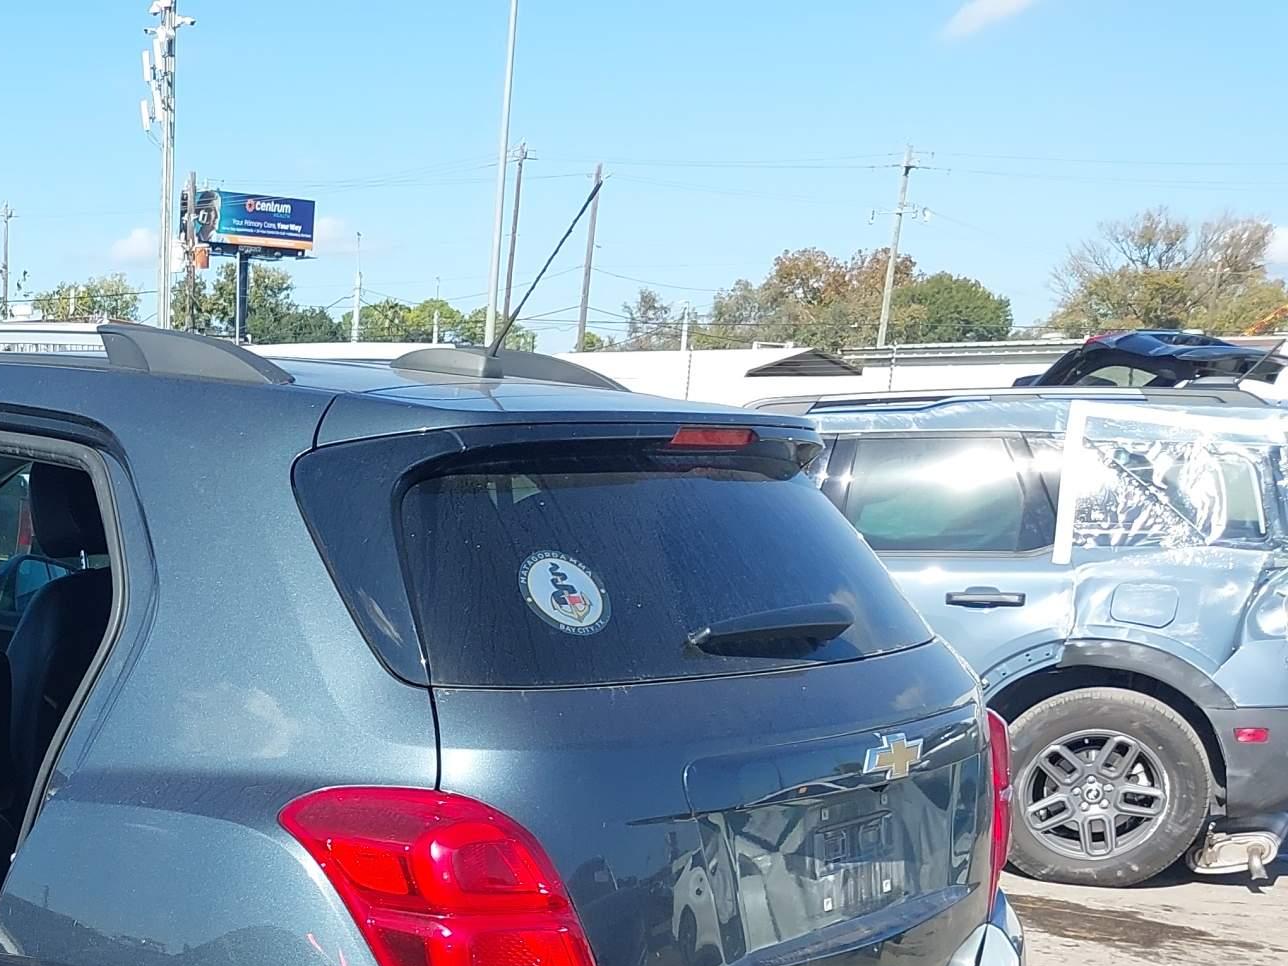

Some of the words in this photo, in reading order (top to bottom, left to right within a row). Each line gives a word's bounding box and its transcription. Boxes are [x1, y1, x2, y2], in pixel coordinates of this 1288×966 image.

[255, 201, 291, 213] centrum
[520, 552, 567, 584] MATAGORDA
[559, 623, 576, 633] BAY
